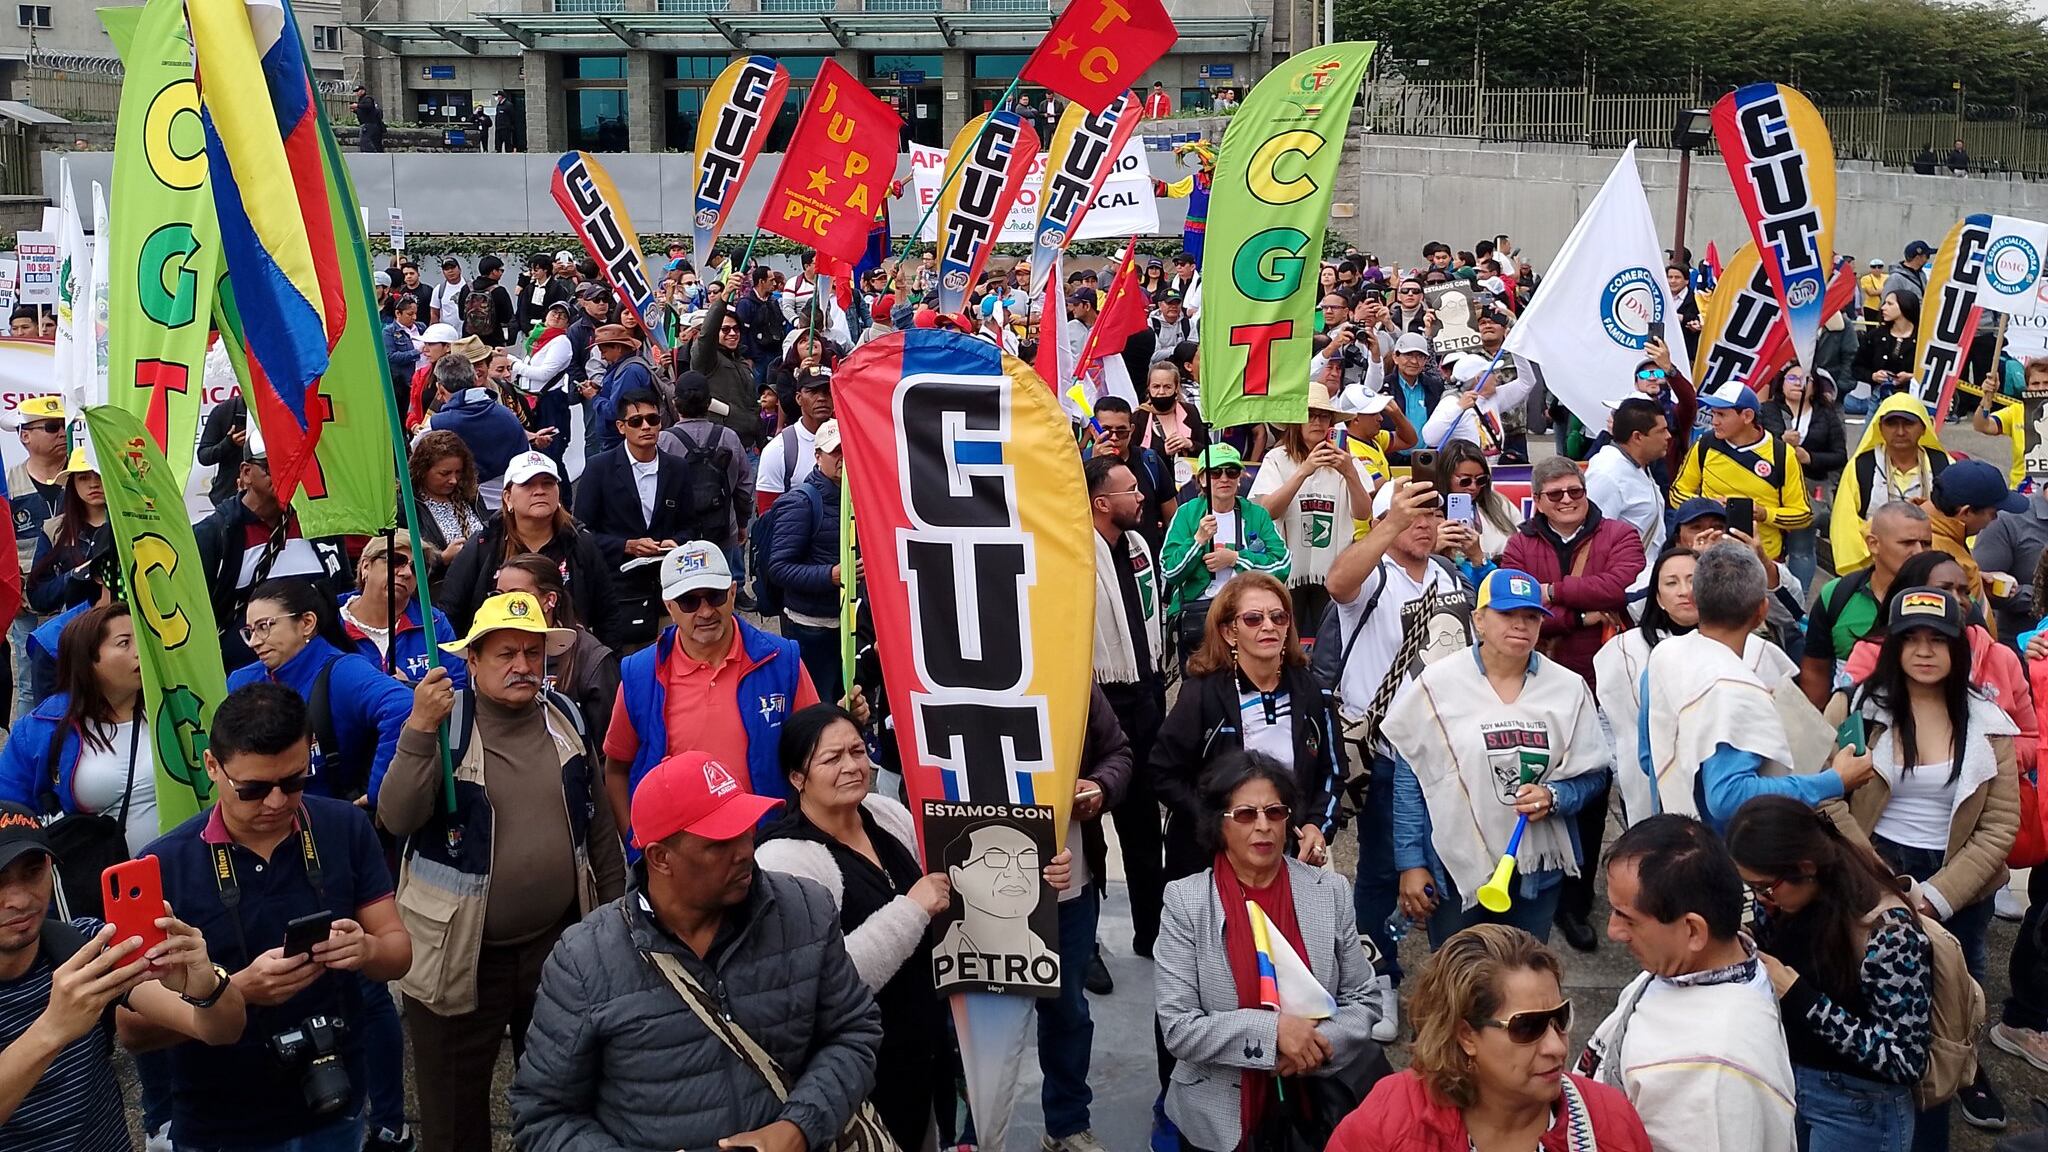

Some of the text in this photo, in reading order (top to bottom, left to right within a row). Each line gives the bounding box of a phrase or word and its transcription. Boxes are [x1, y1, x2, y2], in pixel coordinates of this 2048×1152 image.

[702, 65, 775, 202] CUT
[949, 122, 1018, 266] CUT
[1740, 98, 1821, 273] CUT
[565, 161, 650, 305] CUT
[783, 199, 834, 237] PTC
[1229, 129, 1327, 397] CGT
[1999, 260, 2024, 272] DMG
[1423, 279, 1471, 294] ESTAMOS CON
[1993, 279, 2022, 293] FAMILIA
[1603, 316, 1638, 349] FAMILIA
[1925, 228, 1990, 404] CUT
[1433, 334, 1482, 351] PETRO
[900, 381, 1045, 802] CUT
[1444, 592, 1467, 605] CON
[1480, 723, 1493, 731] SOY
[1526, 721, 1547, 729] SUTEQ
[925, 803, 1053, 820] ESTAMOS CON
[303, 830, 315, 860] Nikon
[217, 848, 231, 880] Nikon
[934, 952, 1060, 987] PETRO
